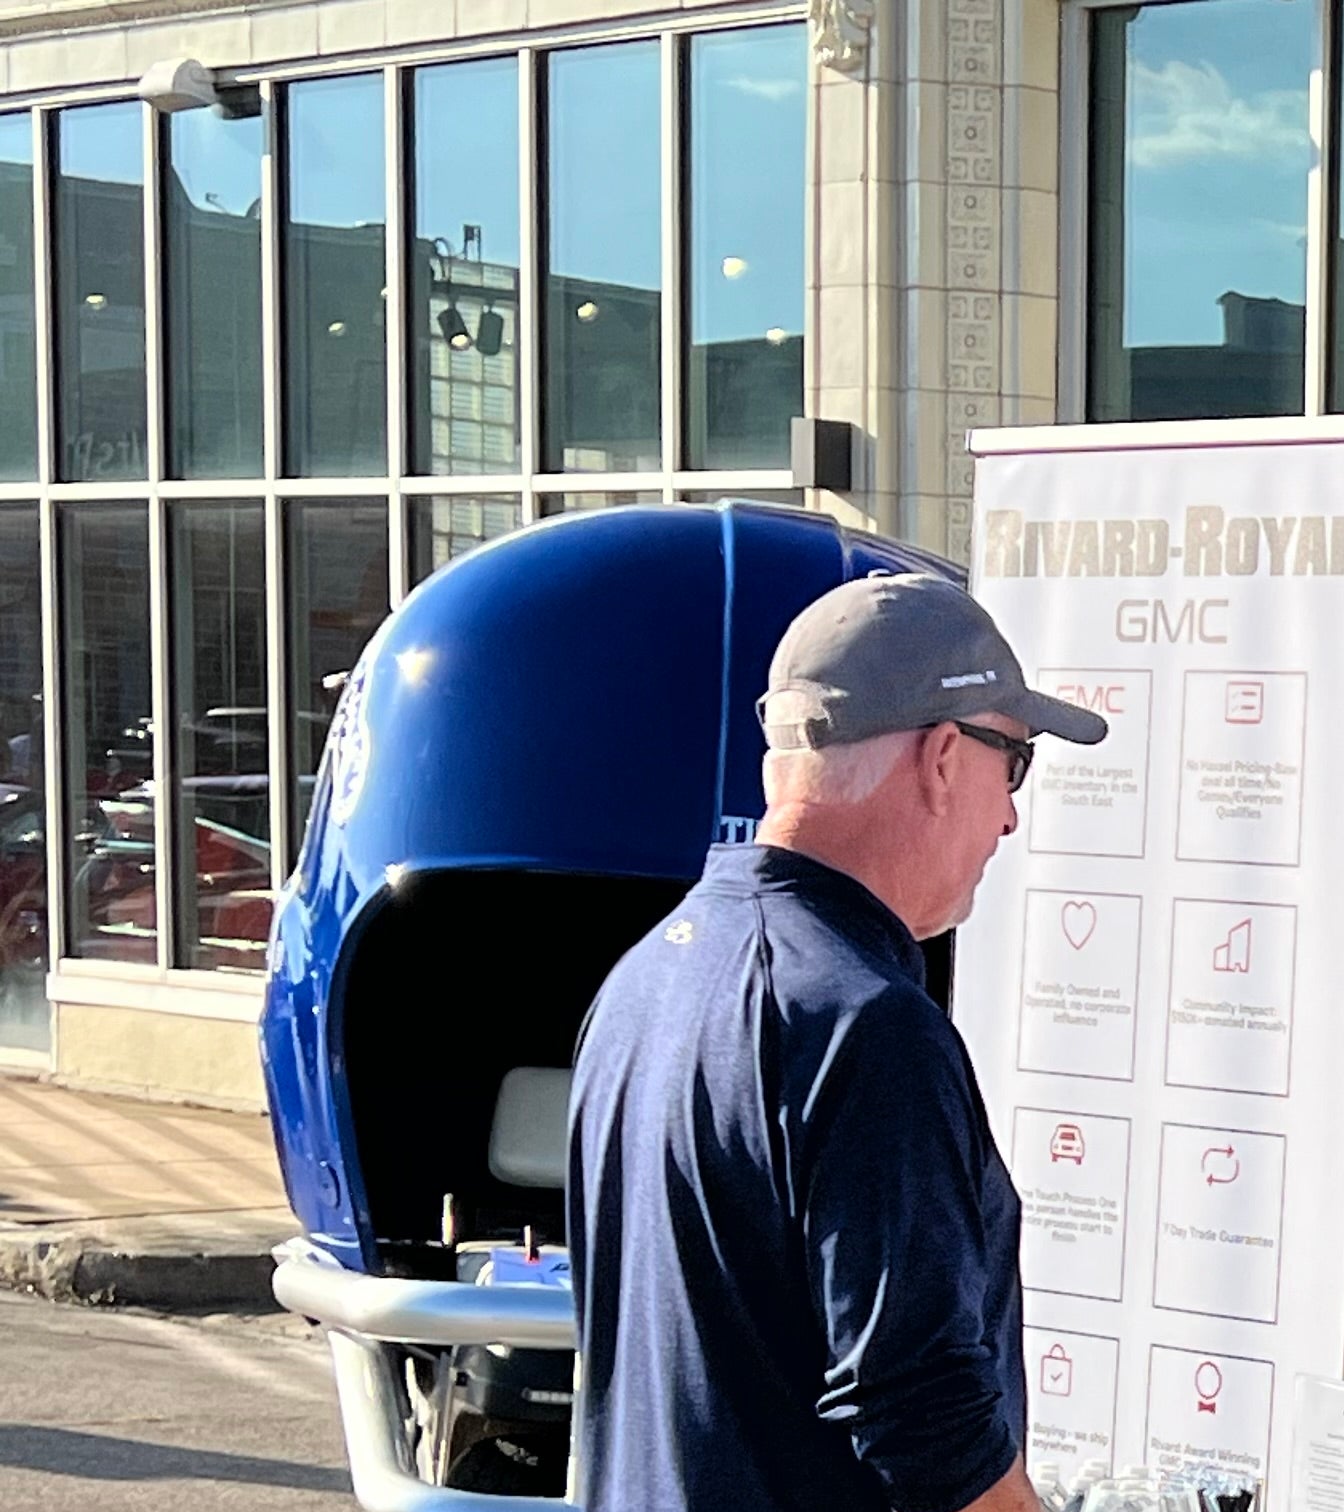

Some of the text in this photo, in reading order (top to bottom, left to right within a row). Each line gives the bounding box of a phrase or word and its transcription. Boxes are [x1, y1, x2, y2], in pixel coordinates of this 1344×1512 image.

[1115, 599, 1229, 644] GMC
[1096, 767, 1133, 781] Largest
[1189, 1225, 1216, 1241] Trade
[1220, 1229, 1274, 1248] Guarantee
